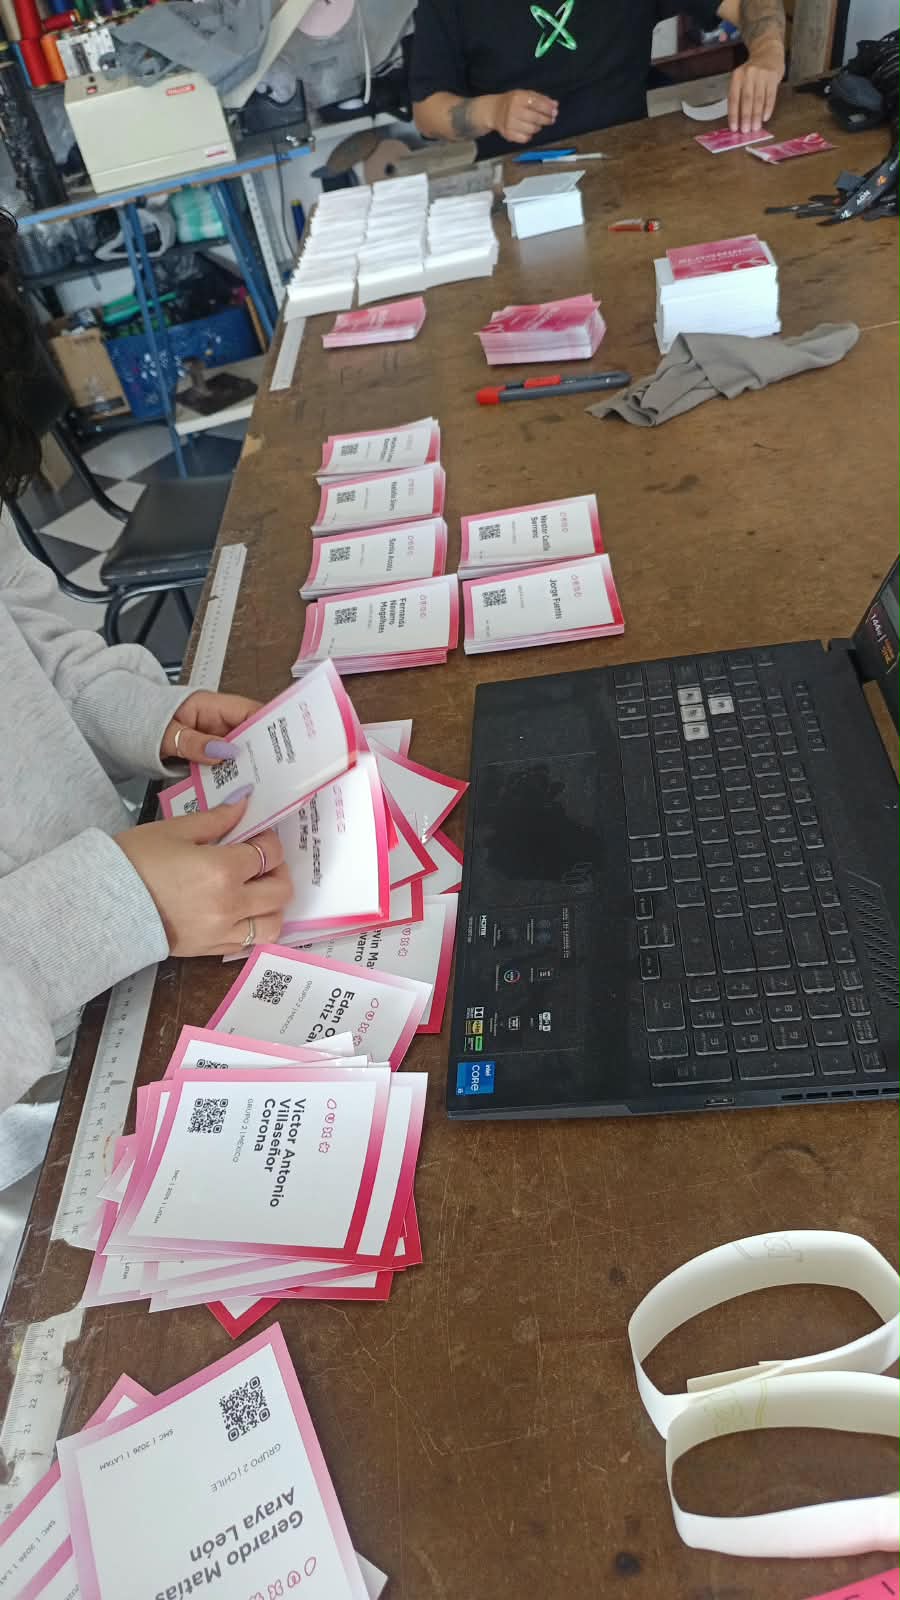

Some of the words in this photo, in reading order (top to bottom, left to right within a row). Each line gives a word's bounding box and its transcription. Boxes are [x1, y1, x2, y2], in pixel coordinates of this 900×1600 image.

[549, 578, 559, 597] Jorge
[354, 931, 369, 962] varro
[371, 928, 382, 949] vin
[366, 951, 380, 970] Ma
[319, 987, 341, 1021] Ortiz
[331, 991, 355, 1024] Eden
[254, 1099, 276, 1152] Corona
[264, 1099, 291, 1173] Villaseñor
[287, 1099, 307, 1144] Victor
[270, 1148, 295, 1208] Antonio
[40, 1351, 49, 1361] 24
[99, 1454, 124, 1471] LATAM
[132, 1440, 151, 1455] 2026
[250, 1443, 282, 1468] GRUPO
[210, 1471, 239, 1493] CHILE
[242, 1463, 249, 1473] 2
[243, 1486, 296, 1530] Araya
[189, 1525, 240, 1563] León
[226, 1509, 304, 1568] Gerardo
[154, 1560, 222, 1600] Matías
